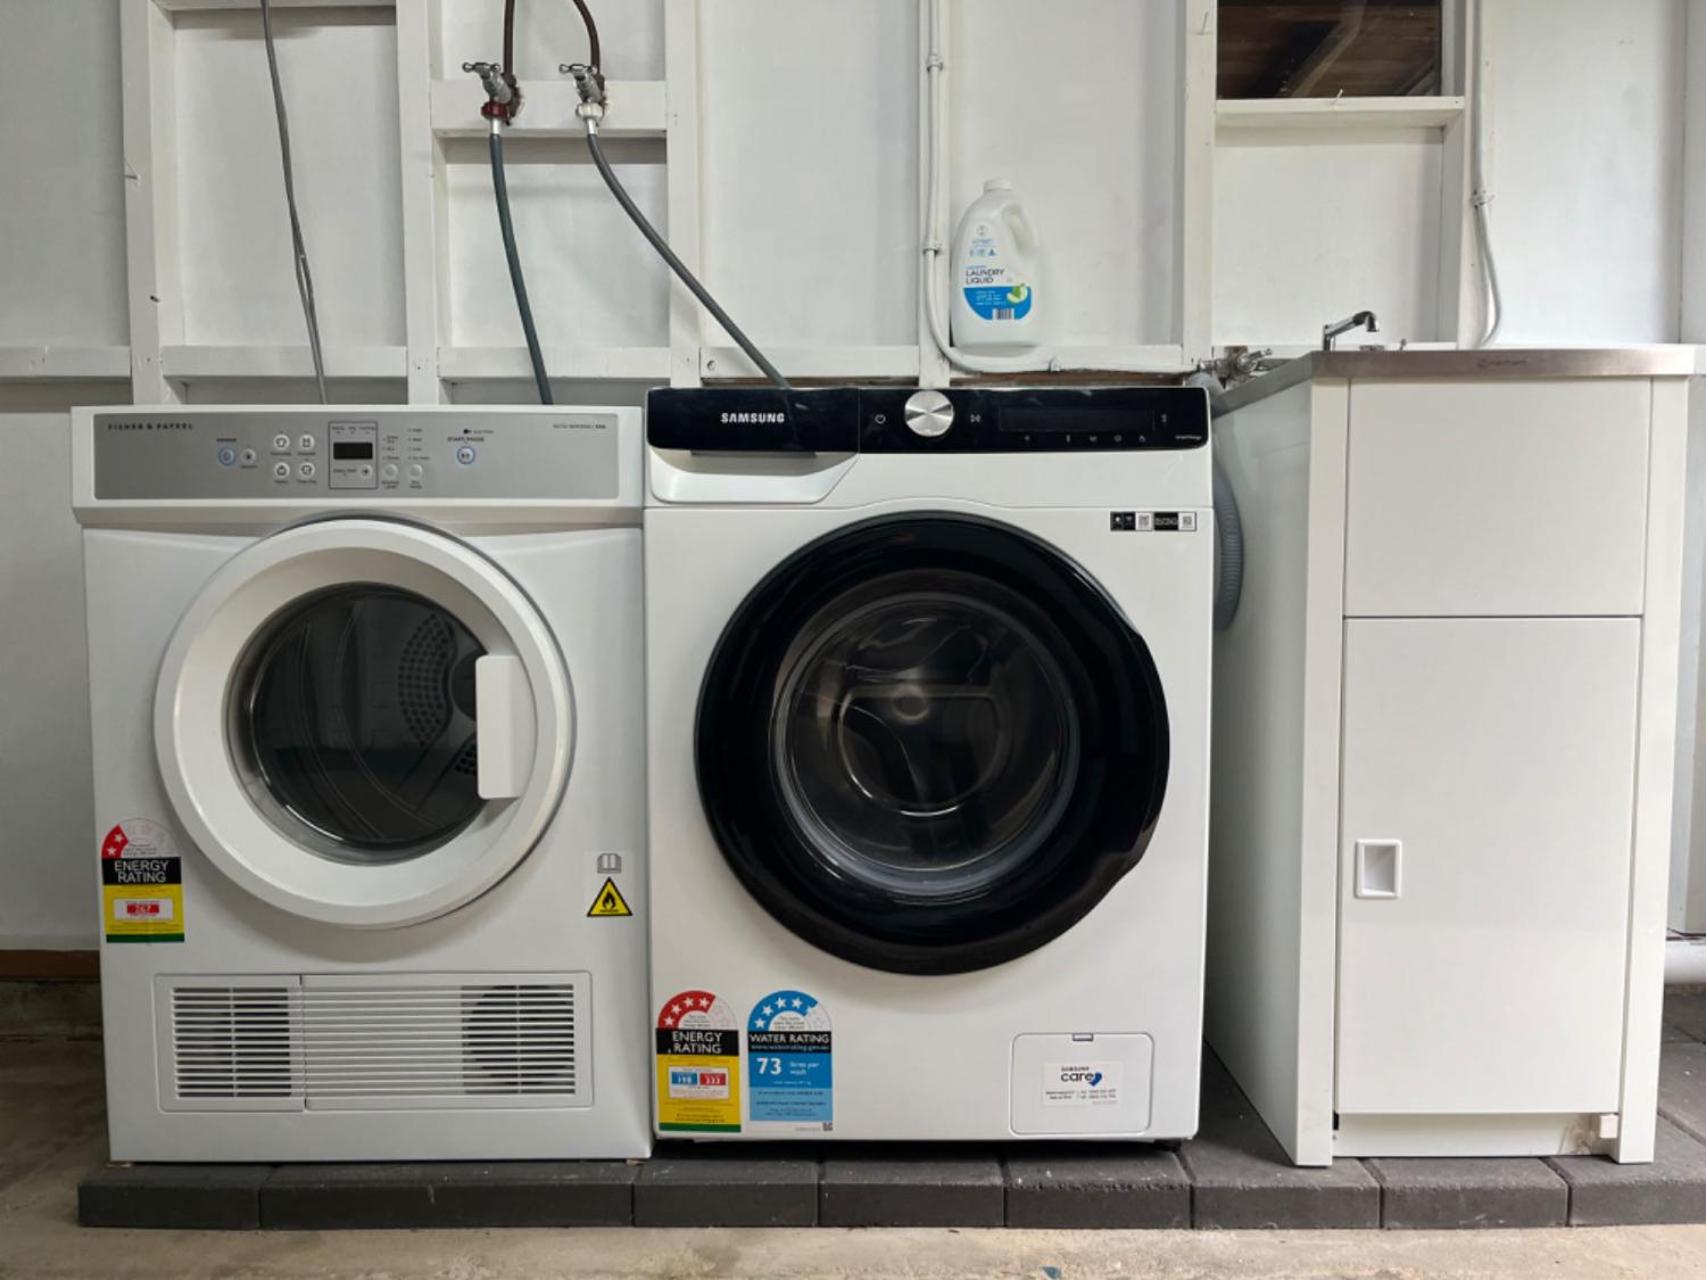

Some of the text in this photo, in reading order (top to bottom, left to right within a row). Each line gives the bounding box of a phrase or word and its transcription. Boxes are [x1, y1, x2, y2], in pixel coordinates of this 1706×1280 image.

[966, 268, 1005, 277] LAUNDRY
[966, 277, 994, 285] LIQUID
[721, 412, 785, 424] SAMSUNG
[114, 860, 169, 872] ENERGY
[117, 871, 167, 883] RATING
[672, 1031, 723, 1043] ENERGY
[750, 1033, 830, 1044] WATER RATING
[673, 1043, 722, 1054] RATING
[756, 1057, 782, 1076] 73
[1060, 1072, 1094, 1083] care
